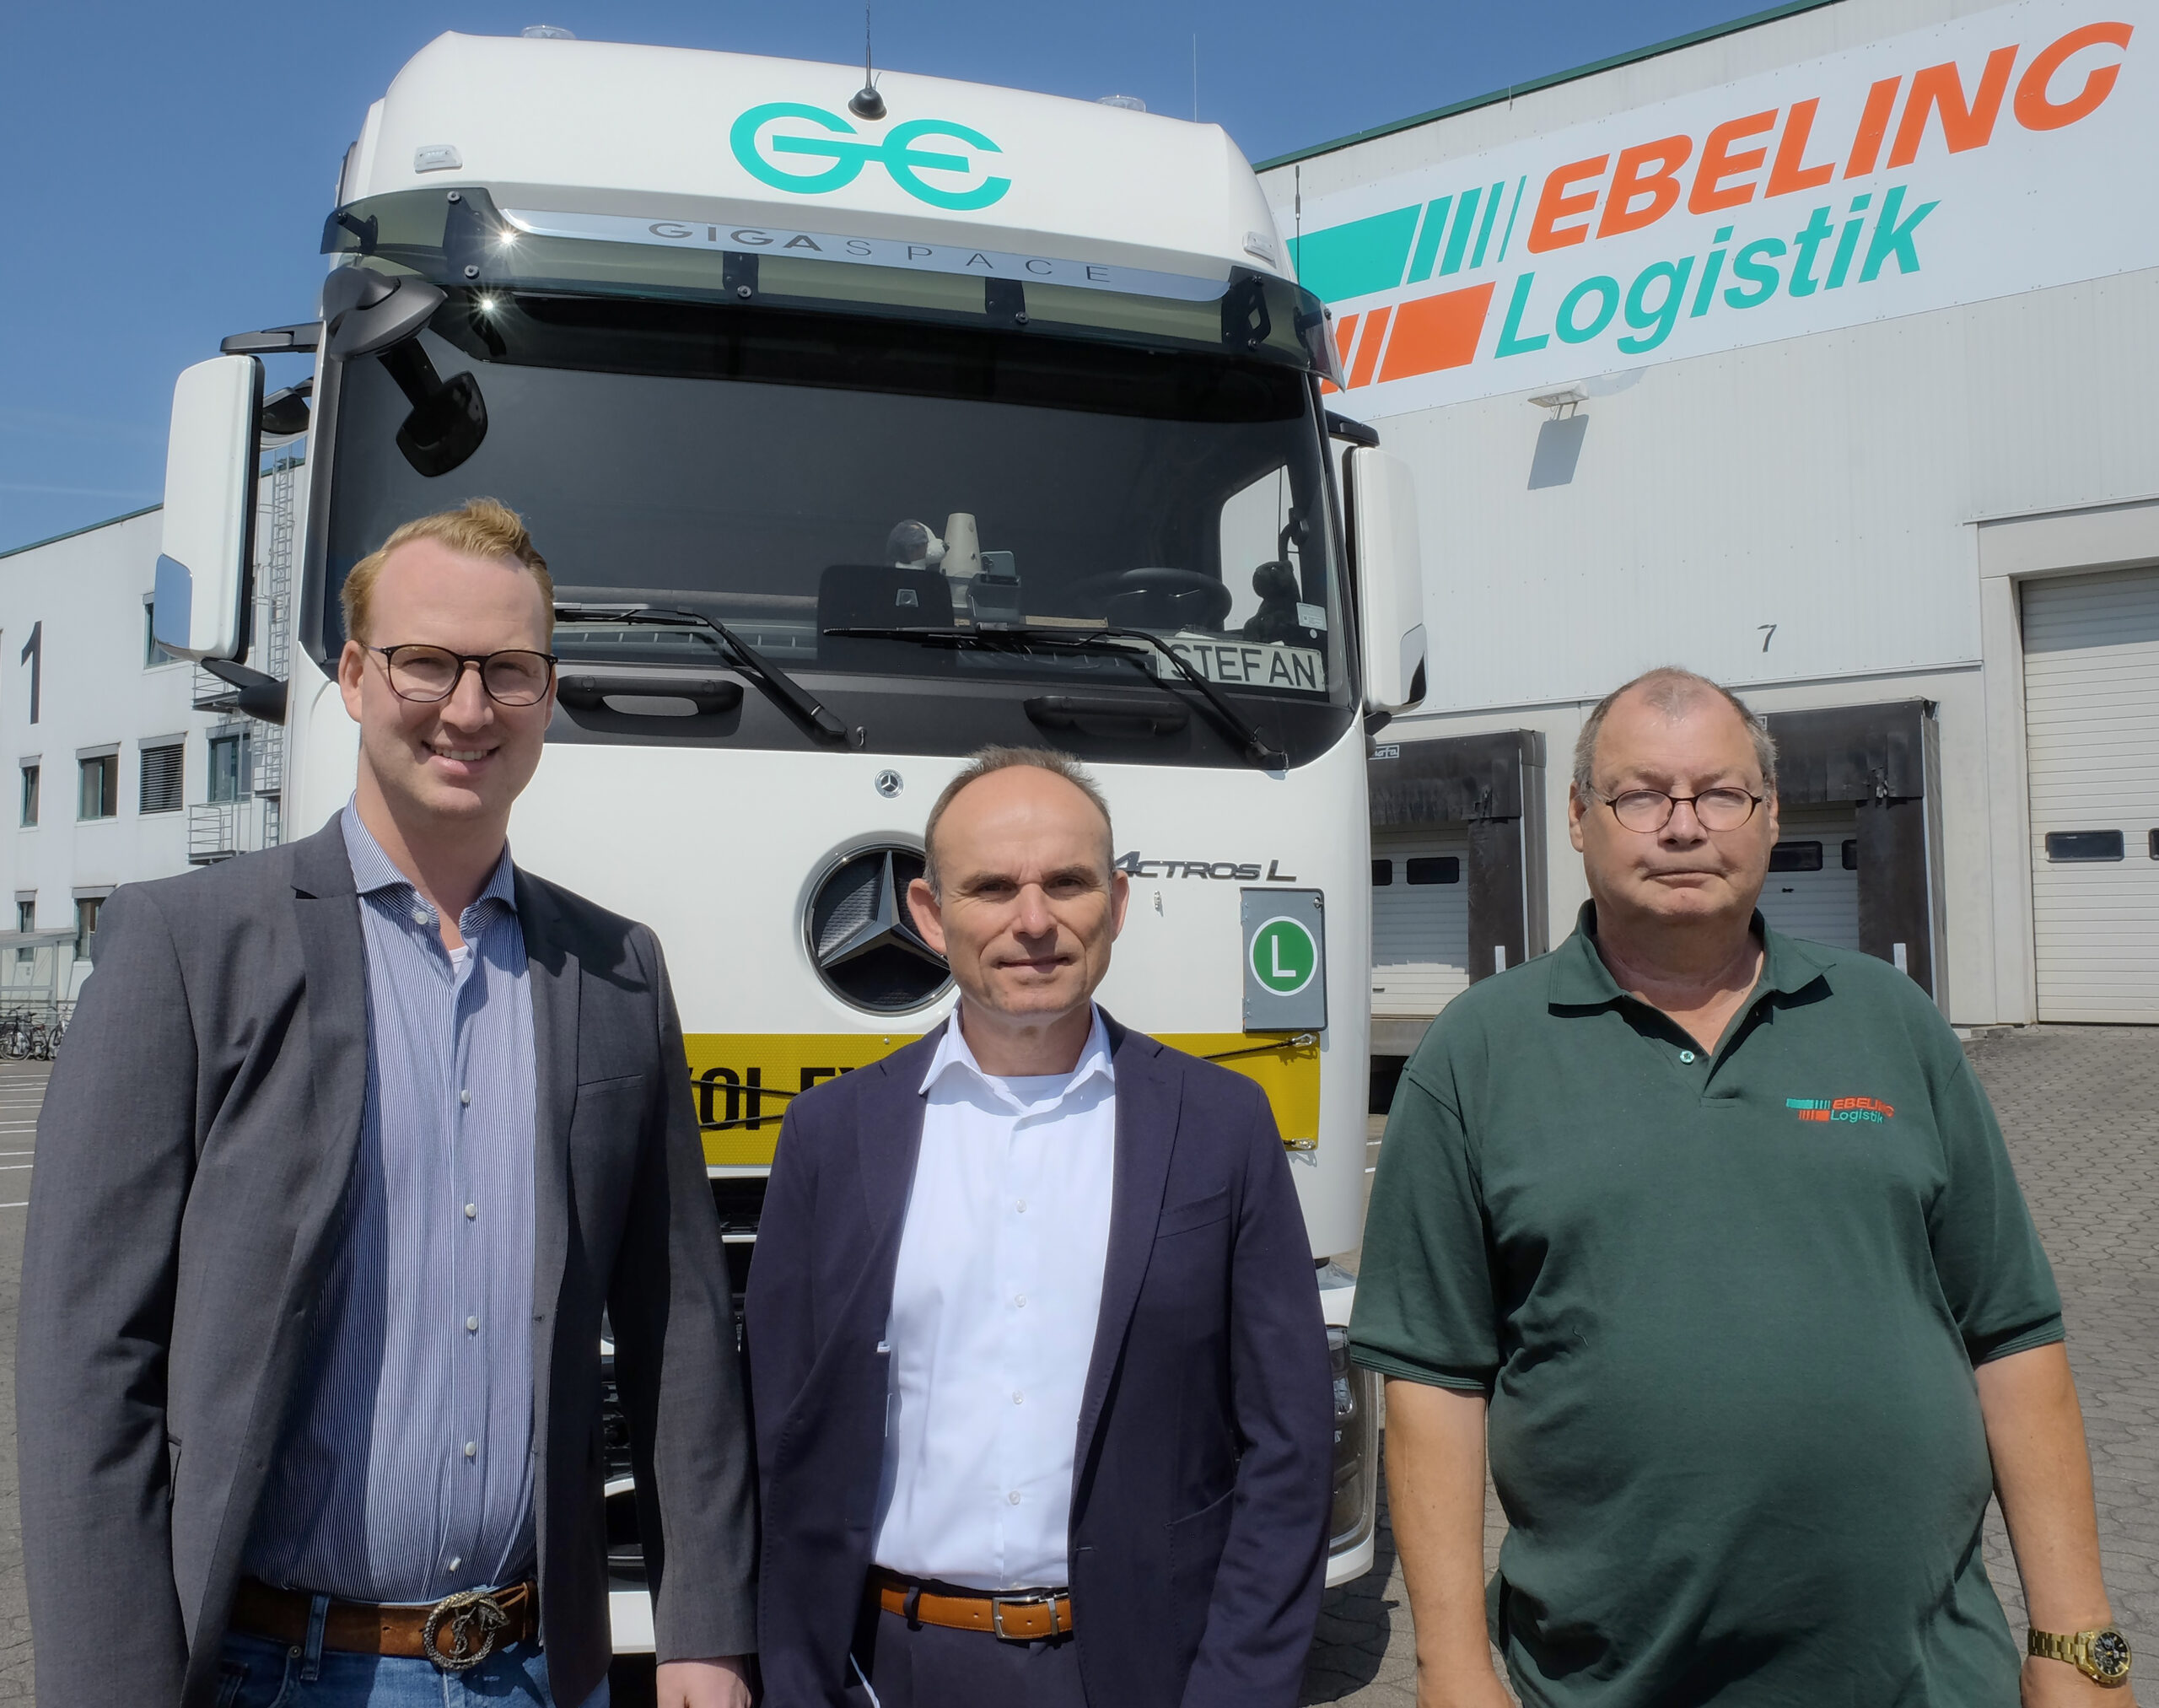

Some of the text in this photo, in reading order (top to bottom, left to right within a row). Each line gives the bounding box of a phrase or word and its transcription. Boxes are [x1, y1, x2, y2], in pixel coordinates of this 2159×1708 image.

[1527, 21, 2135, 254] EBELING
[1494, 185, 1941, 358] Logistik
[1757, 624, 1777, 653] 7
[1169, 644, 1316, 689] STEFAN
[1114, 851, 1297, 882] ACTROS L
[1271, 935, 1296, 978] L
[1830, 1109, 1883, 1123] Logistik
[1832, 1097, 1894, 1118] EBELING
